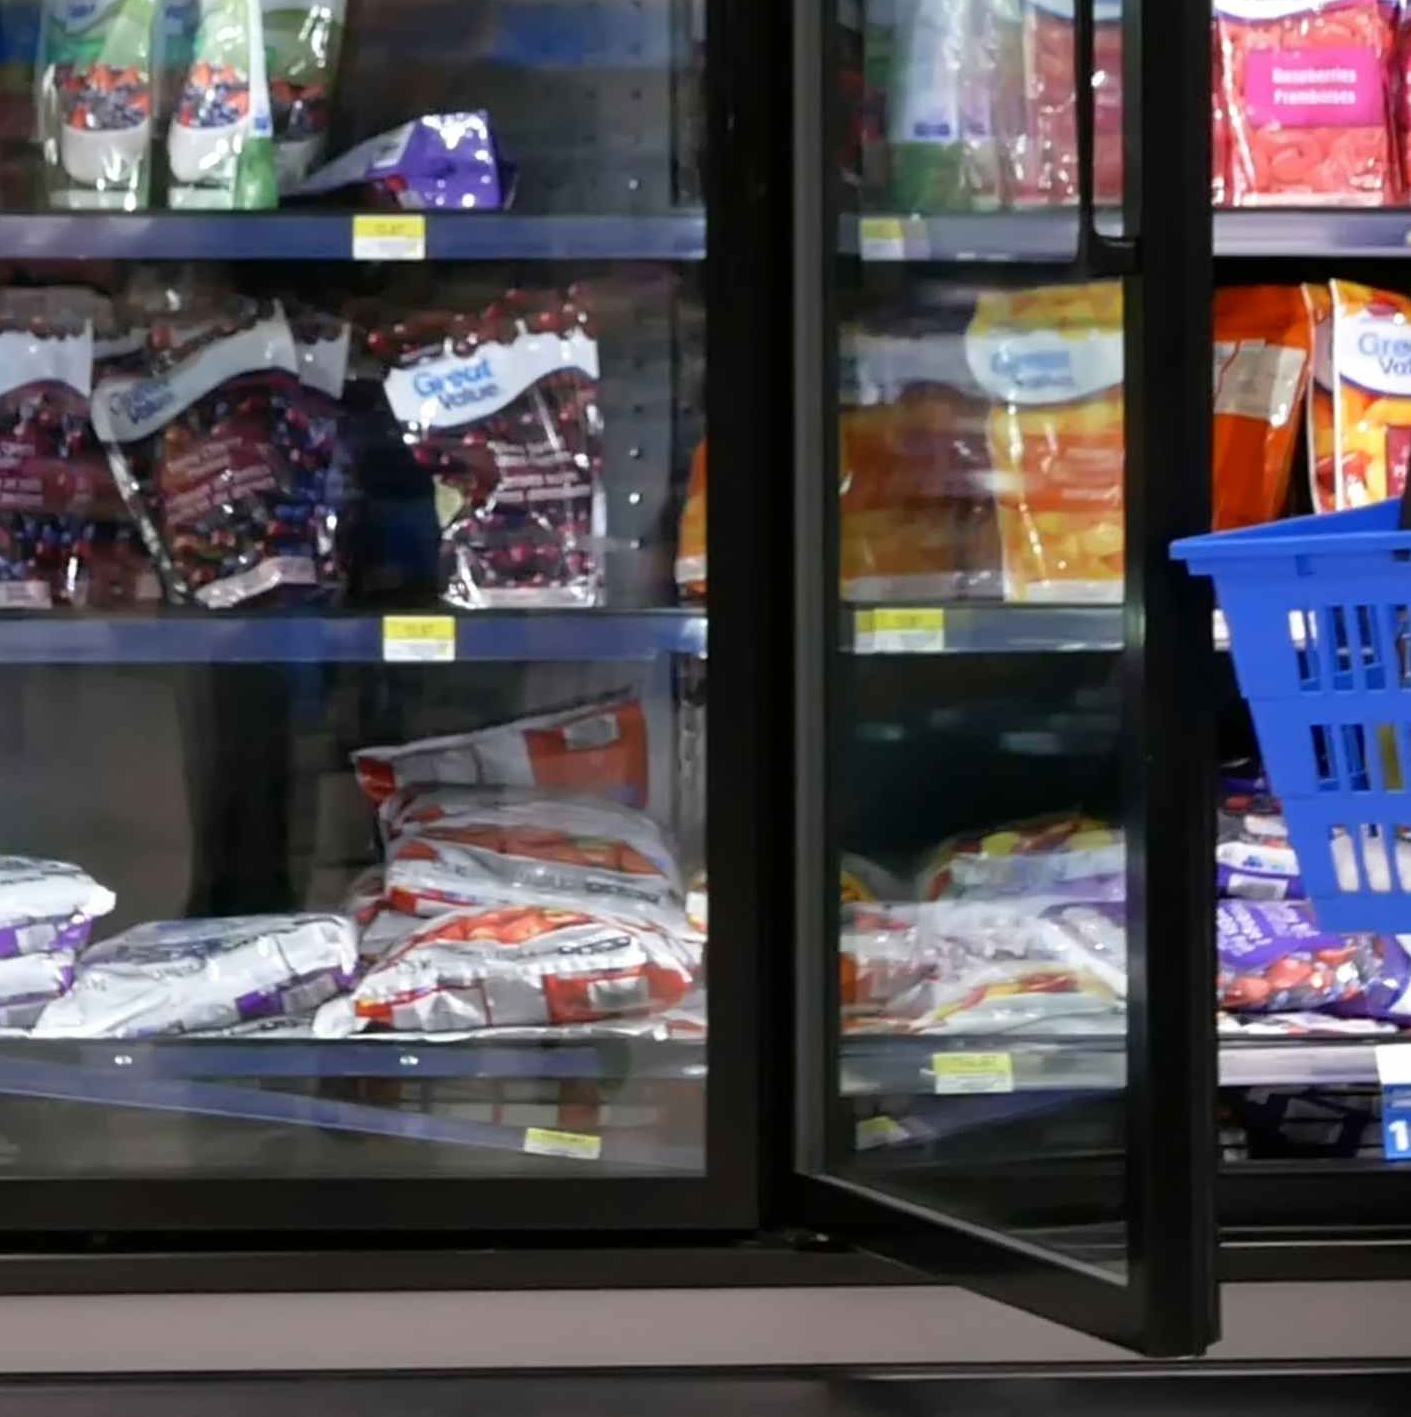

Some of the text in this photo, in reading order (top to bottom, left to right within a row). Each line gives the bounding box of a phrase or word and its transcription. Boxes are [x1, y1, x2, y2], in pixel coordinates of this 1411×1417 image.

[1270, 64, 1358, 87] Raspberries
[1272, 87, 1357, 107] Framboises
[412, 358, 493, 399] Great
[437, 381, 498, 412] Value
